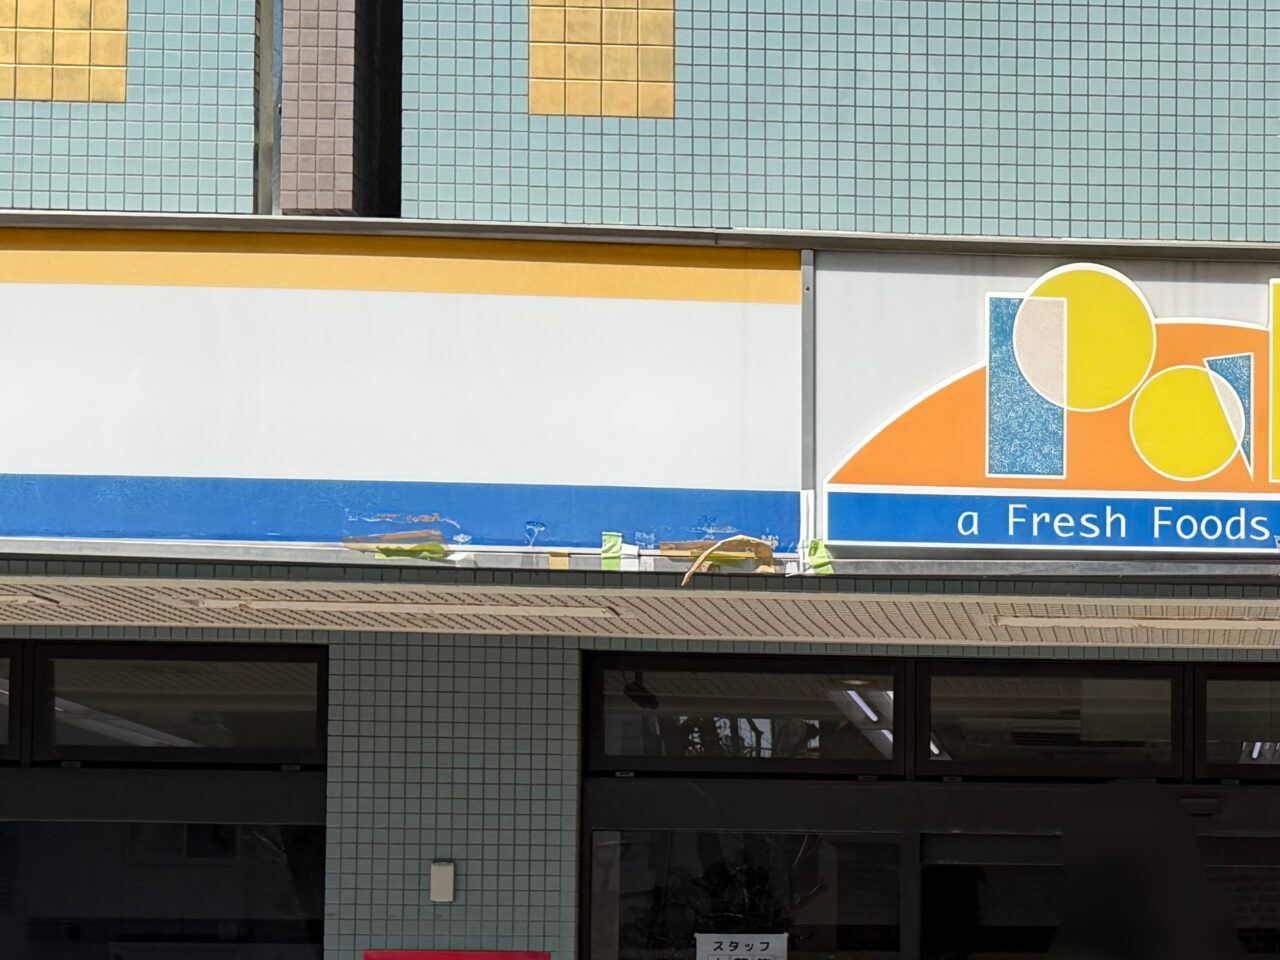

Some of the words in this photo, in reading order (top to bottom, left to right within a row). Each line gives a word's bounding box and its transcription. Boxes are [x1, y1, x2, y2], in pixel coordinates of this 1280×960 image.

[957, 511, 979, 535] a
[1008, 504, 1127, 539] Fresh
[1154, 507, 1270, 540] Foods
[713, 941, 770, 952] スタッフ
